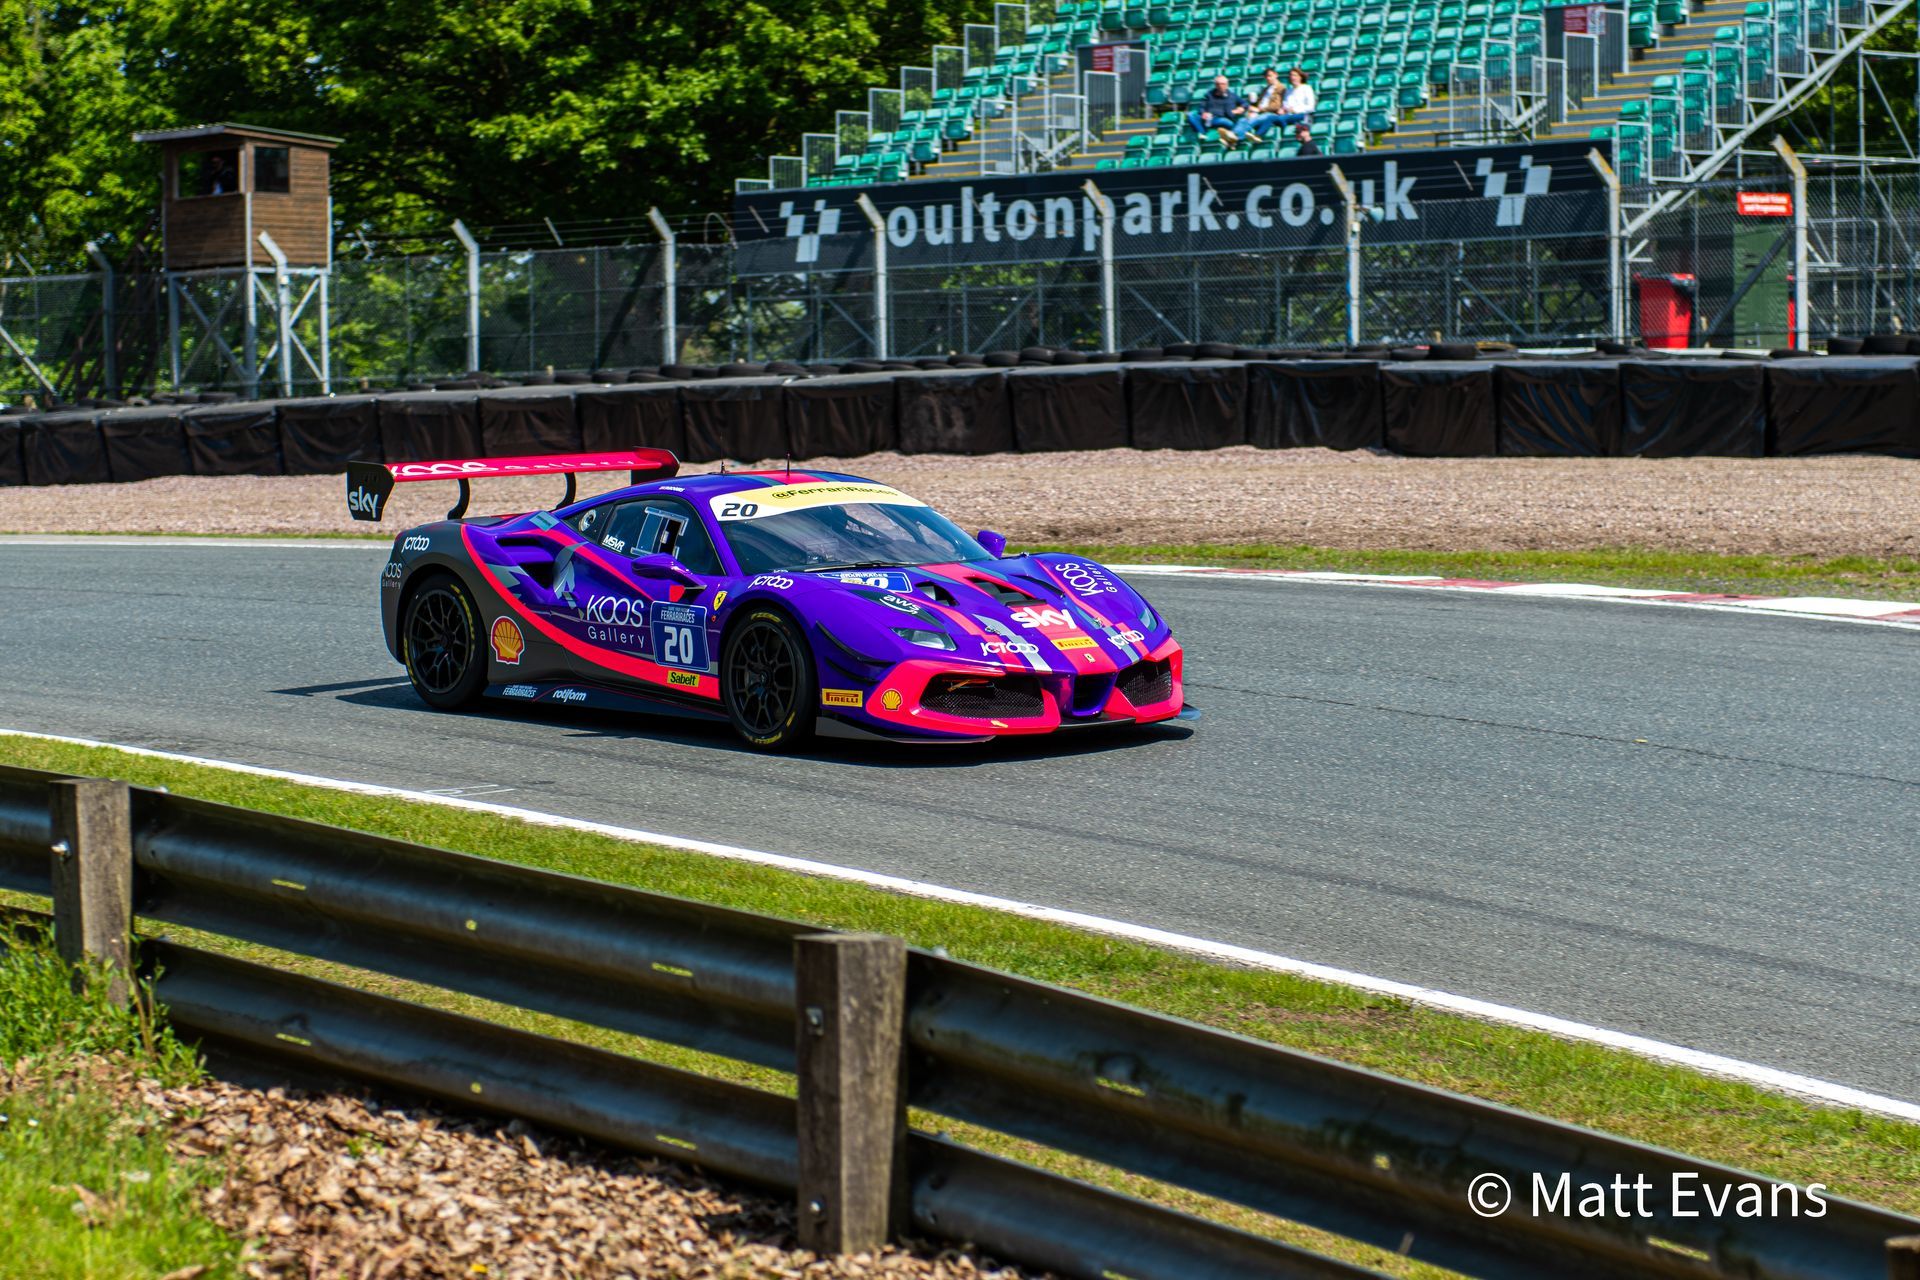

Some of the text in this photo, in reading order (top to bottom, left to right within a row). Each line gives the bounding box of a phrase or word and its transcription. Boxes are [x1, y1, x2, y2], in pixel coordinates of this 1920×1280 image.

[887, 159, 1419, 252] oultonpark.co.uk
[349, 485, 379, 519] sky
[721, 502, 759, 517] 20
[602, 534, 625, 552] MSVR
[1055, 562, 1105, 597] KOOS
[587, 594, 645, 628] KOOS
[883, 594, 921, 612] aws
[1010, 606, 1078, 630] sky
[587, 625, 645, 649] Gallery
[663, 625, 694, 665] 20
[670, 671, 698, 686] Sabelt
[552, 688, 587, 703] rotiform
[826, 691, 861, 705] PIRELLI
